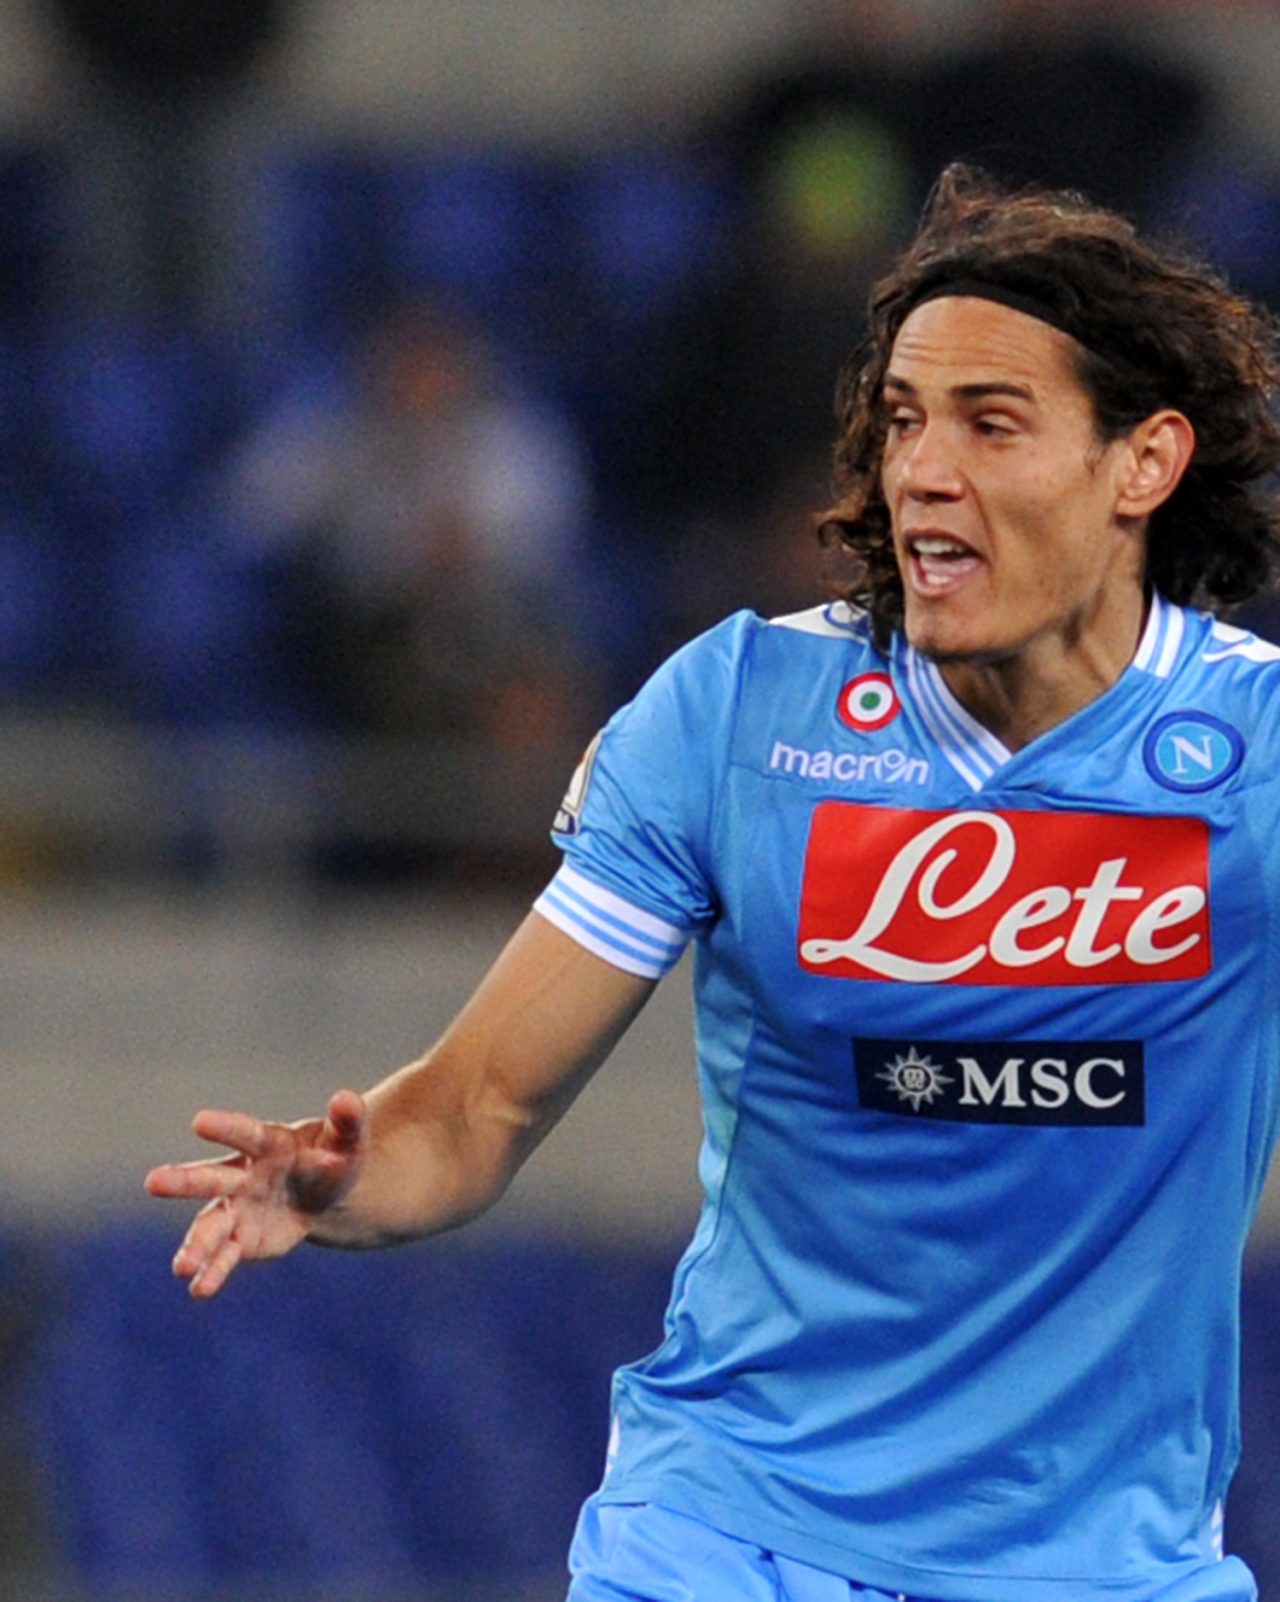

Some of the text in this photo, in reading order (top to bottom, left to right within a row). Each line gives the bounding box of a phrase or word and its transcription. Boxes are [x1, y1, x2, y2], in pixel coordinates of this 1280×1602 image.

[770, 741, 930, 785] macron
[1170, 734, 1213, 775] N
[800, 810, 1206, 983] Lete
[955, 1057, 1126, 1109] MSC
